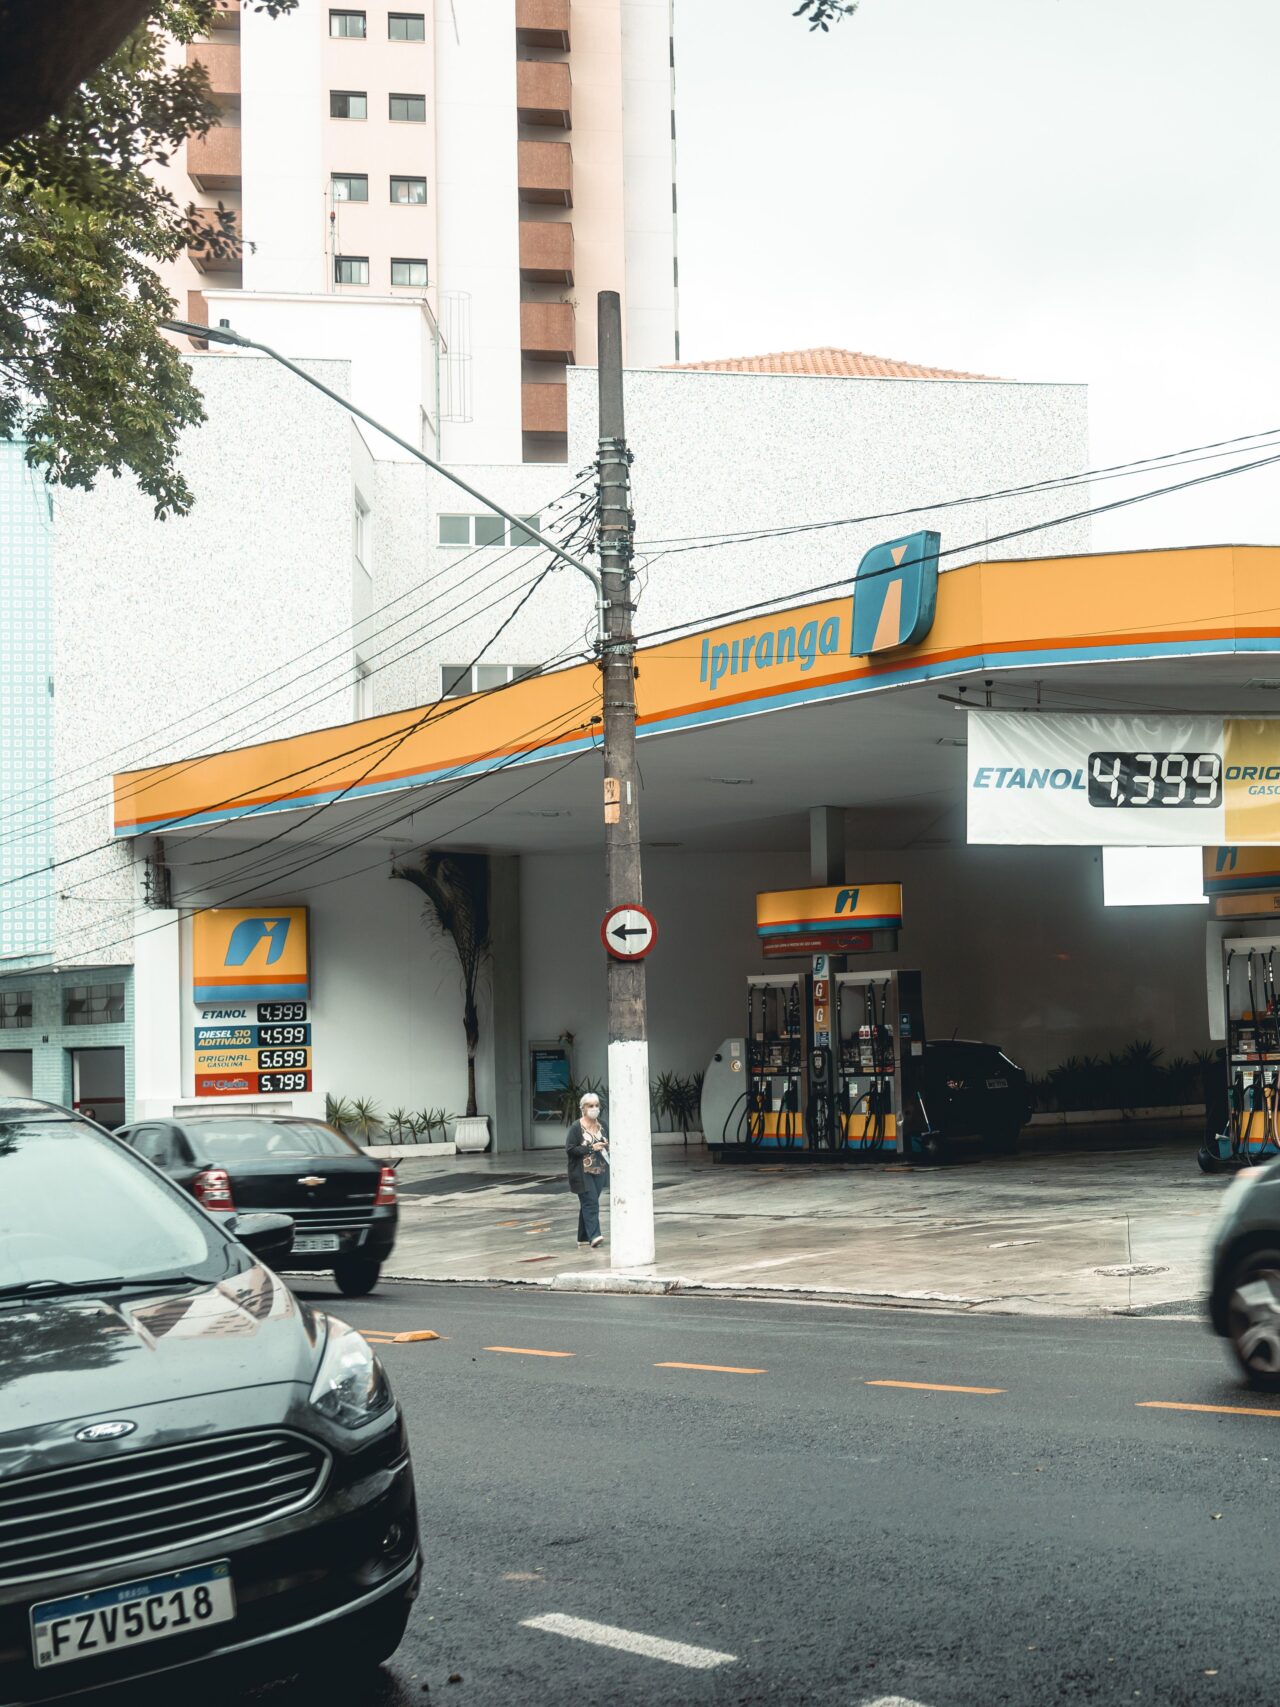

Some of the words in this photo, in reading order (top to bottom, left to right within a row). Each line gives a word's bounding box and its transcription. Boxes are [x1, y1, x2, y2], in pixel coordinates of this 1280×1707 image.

[699, 616, 840, 690] Ipiranga
[973, 767, 1087, 790] ETANOL
[1093, 754, 1220, 807] 4,399
[202, 1009, 248, 1020] ETANOL
[260, 1005, 304, 1021] 4,399
[198, 1037, 252, 1046] ADITIVADO
[199, 1030, 232, 1039] DIESEL
[261, 1027, 305, 1044] 4,599
[198, 1054, 252, 1063] ORIGINAL
[261, 1051, 305, 1068] 5,699
[118, 1585, 150, 1601] BRASIL
[51, 1585, 213, 1657] FZV5C18
